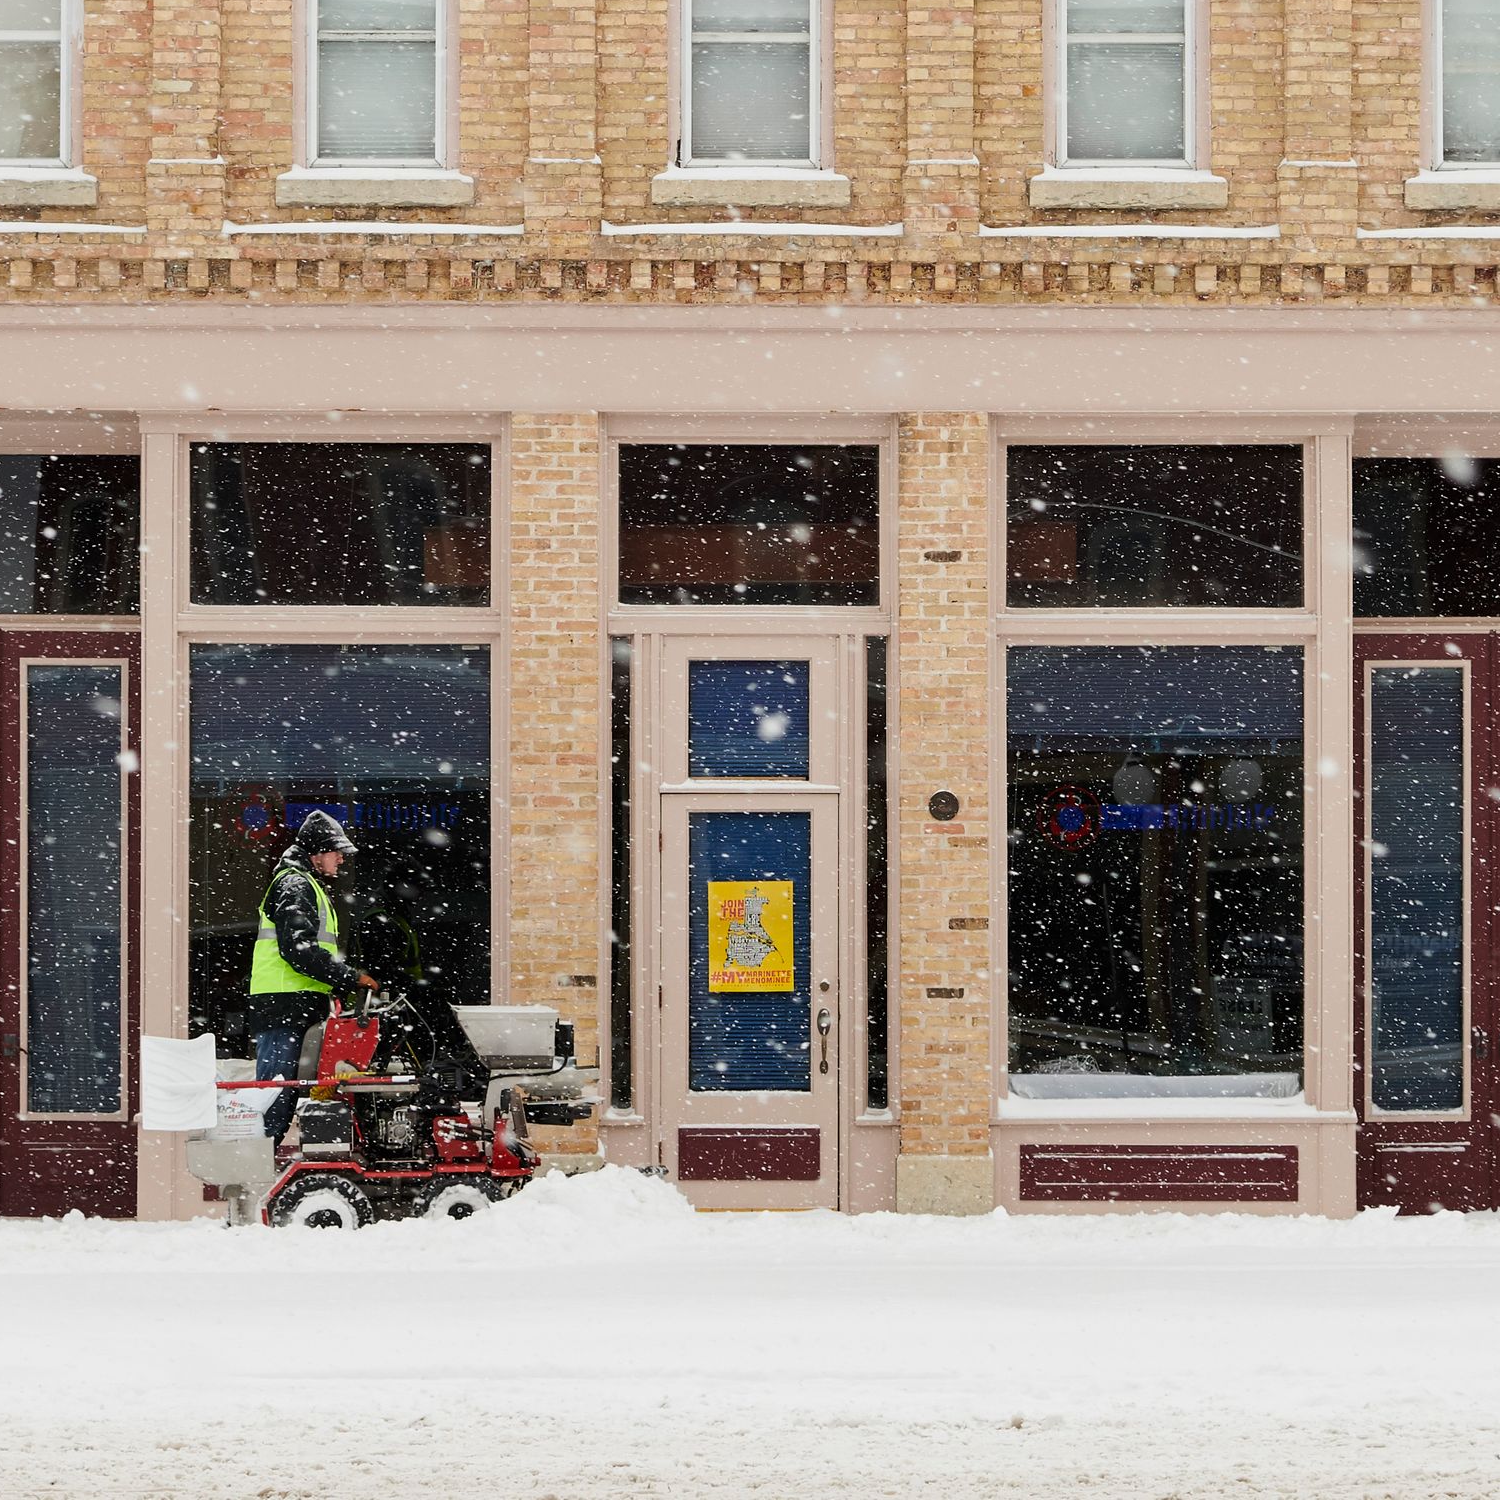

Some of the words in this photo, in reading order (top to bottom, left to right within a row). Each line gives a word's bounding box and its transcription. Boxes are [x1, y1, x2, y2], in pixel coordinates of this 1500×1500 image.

[721, 900, 745, 908] JOIN
[722, 908, 745, 918] THE
[710, 971, 745, 984] #MY
[744, 976, 791, 984] MENOMINEE
